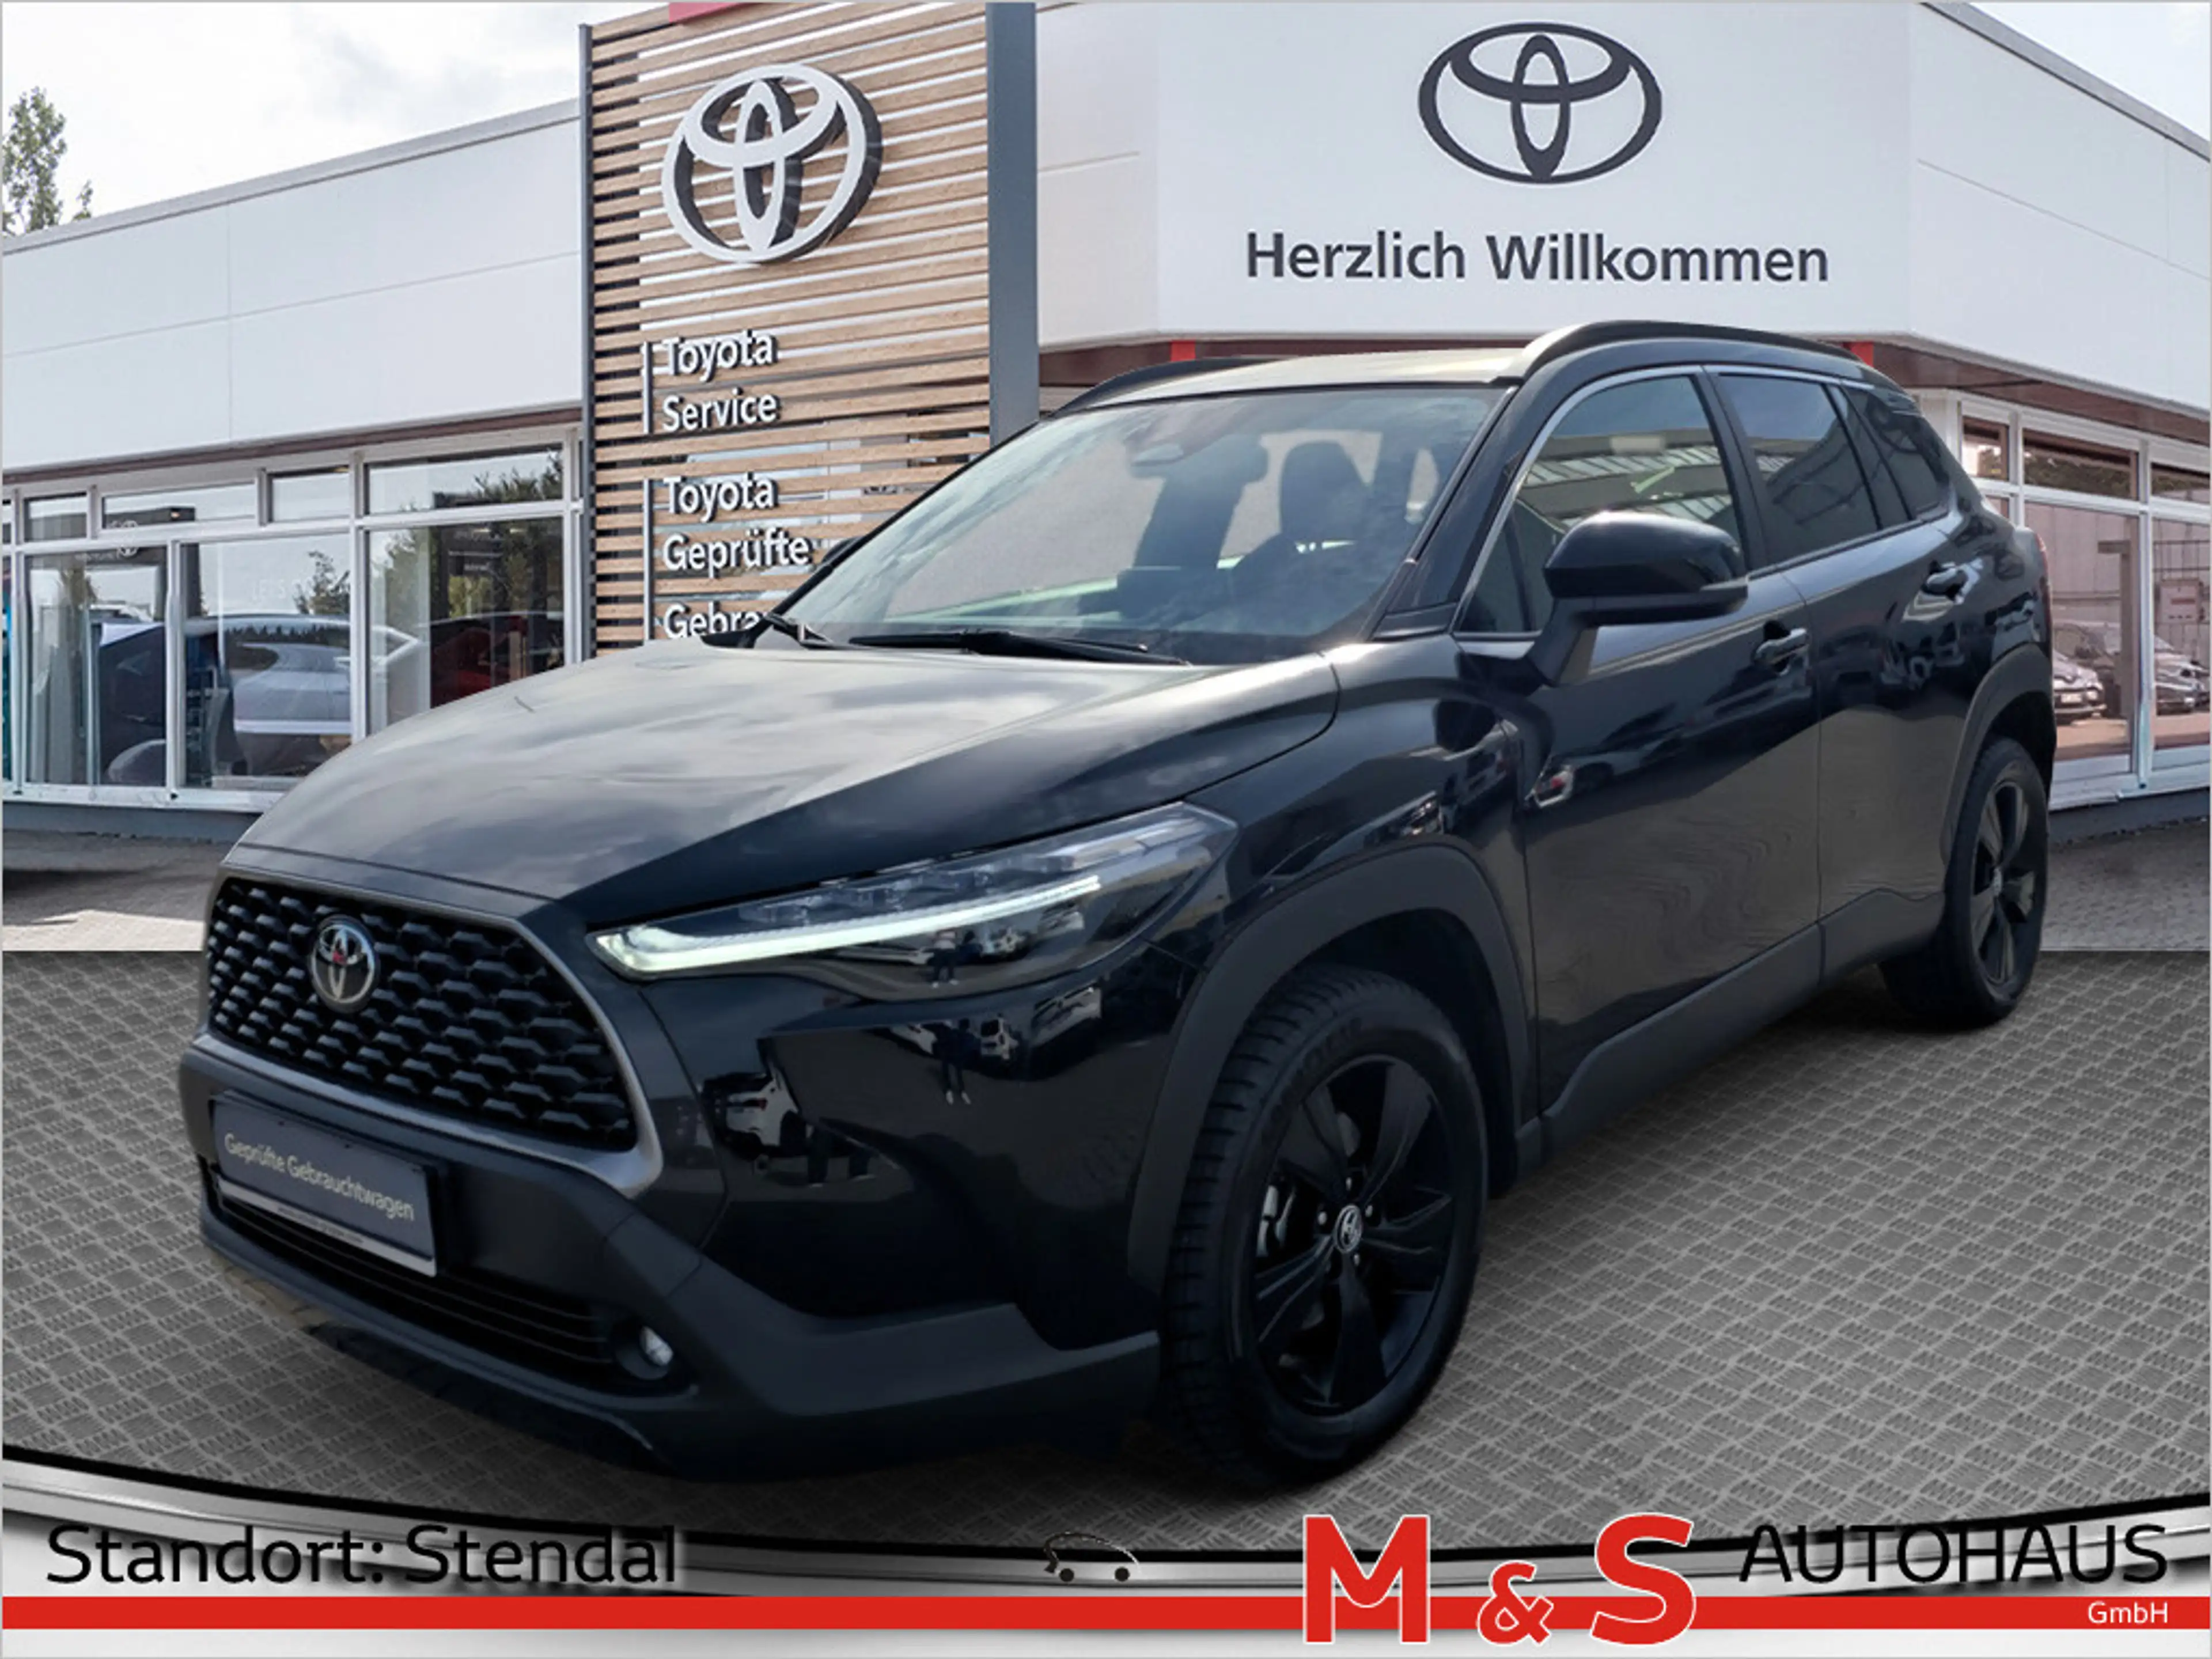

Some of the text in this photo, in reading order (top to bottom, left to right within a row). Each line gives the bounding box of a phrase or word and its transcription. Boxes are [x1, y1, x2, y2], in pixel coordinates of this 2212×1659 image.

[1247, 230, 1828, 282] Herzlich Willkommen
[662, 330, 775, 381] Toyota
[662, 388, 777, 432] Service
[662, 474, 775, 522] Toyota
[662, 528, 809, 578] Geprüfte
[664, 601, 768, 639] Gebra
[224, 1132, 415, 1221] Geprüfte Gebrauchtwagen
